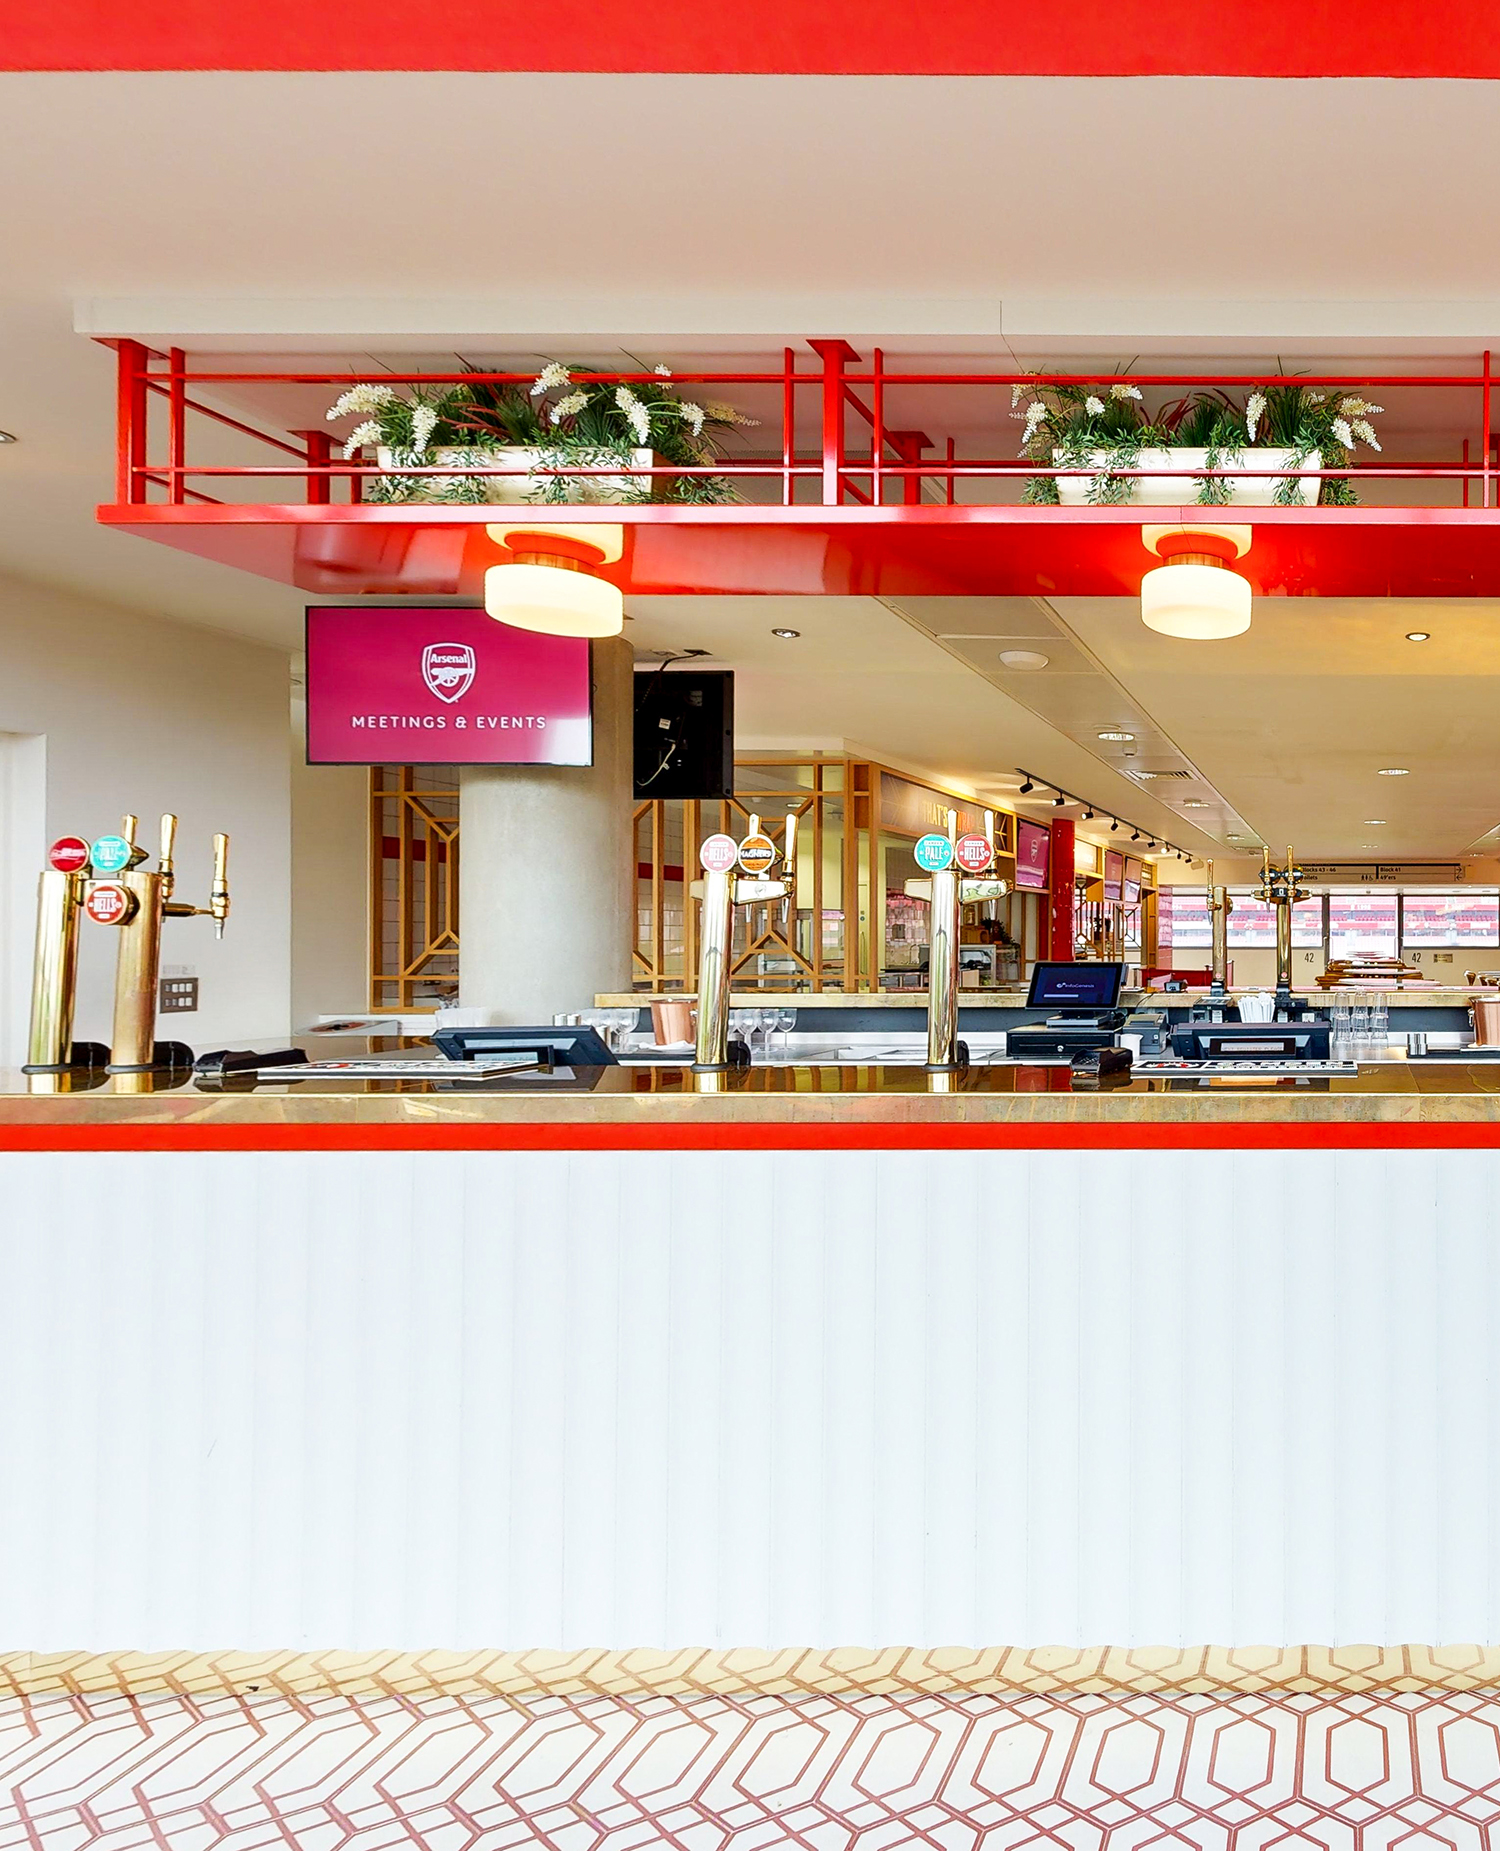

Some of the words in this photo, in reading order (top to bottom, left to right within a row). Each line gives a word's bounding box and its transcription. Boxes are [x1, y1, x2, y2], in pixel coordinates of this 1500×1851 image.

[430, 653, 469, 664] Arsenal
[352, 715, 447, 729] MEETINGS
[455, 715, 467, 729] &
[476, 716, 546, 729] EVENTS
[925, 846, 943, 860] PALE
[964, 846, 985, 860] HELLS
[1305, 953, 1314, 962] 42
[1411, 953, 1422, 962] 42
